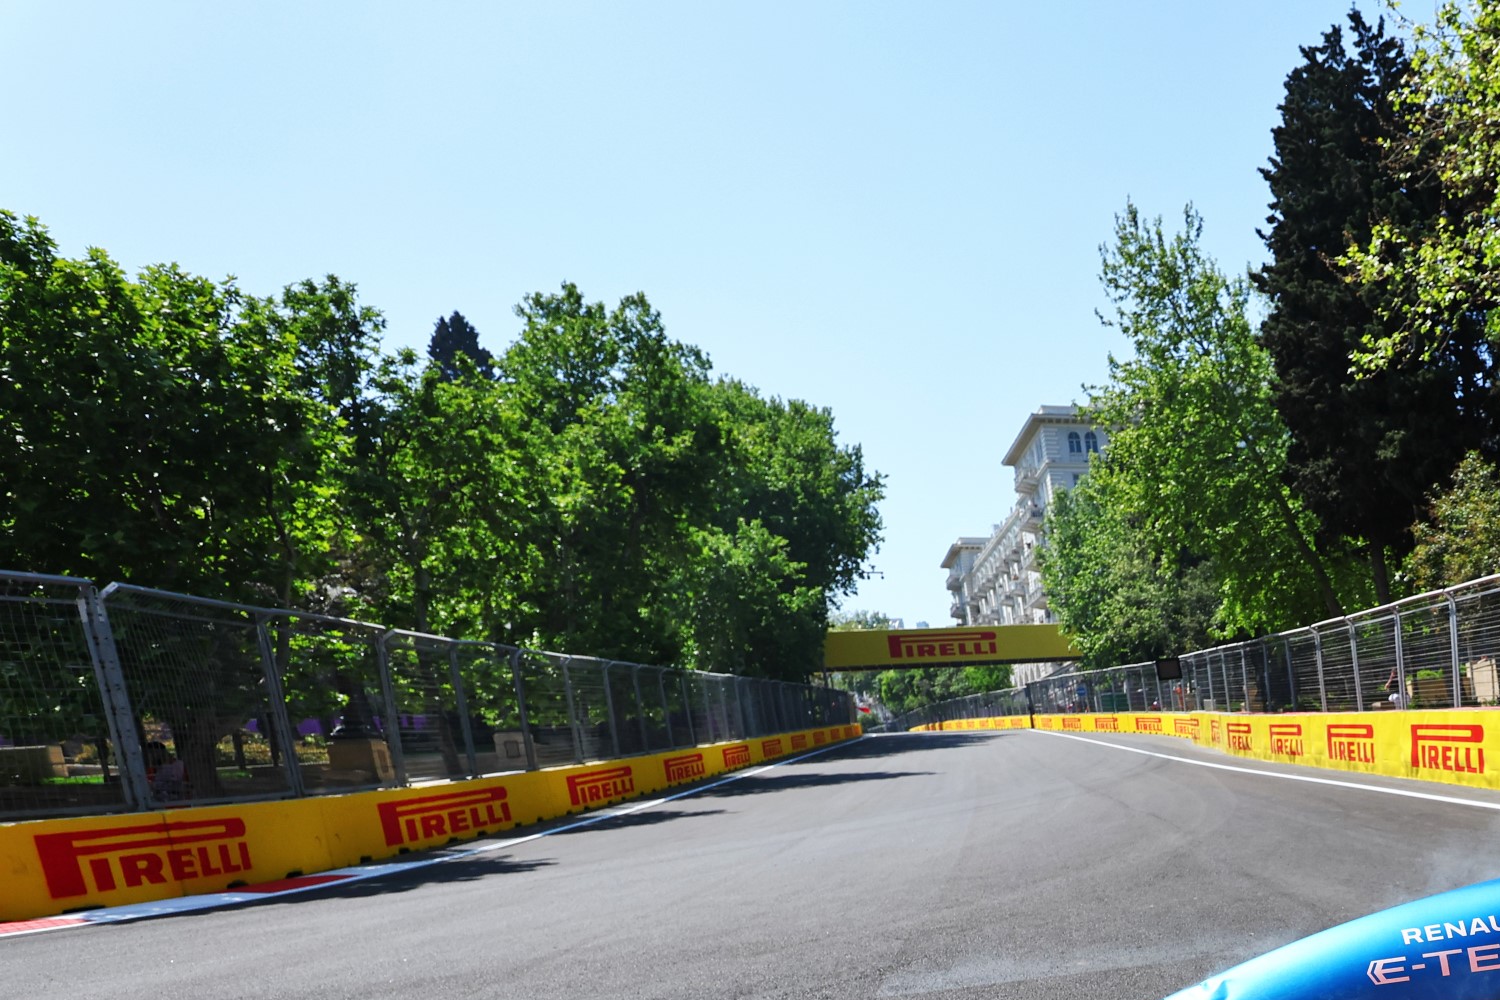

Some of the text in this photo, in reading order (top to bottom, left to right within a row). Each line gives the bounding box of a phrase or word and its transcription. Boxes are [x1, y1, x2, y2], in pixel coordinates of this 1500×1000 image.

[888, 632, 997, 658] PIRELLI
[1095, 717, 1119, 731] PIRELLI
[1135, 717, 1162, 732] PIRELLI
[1227, 723, 1252, 751] PRELLI
[1271, 723, 1303, 757] PIRELLI
[722, 745, 751, 769] PIRELLI
[1327, 723, 1375, 763] PIRELLI
[1411, 724, 1485, 774] PIRELLI
[664, 753, 706, 783] PIRELLI
[566, 766, 635, 806] PIRELLI
[378, 786, 512, 847] PIRELLI
[33, 817, 252, 899] PIRELLI
